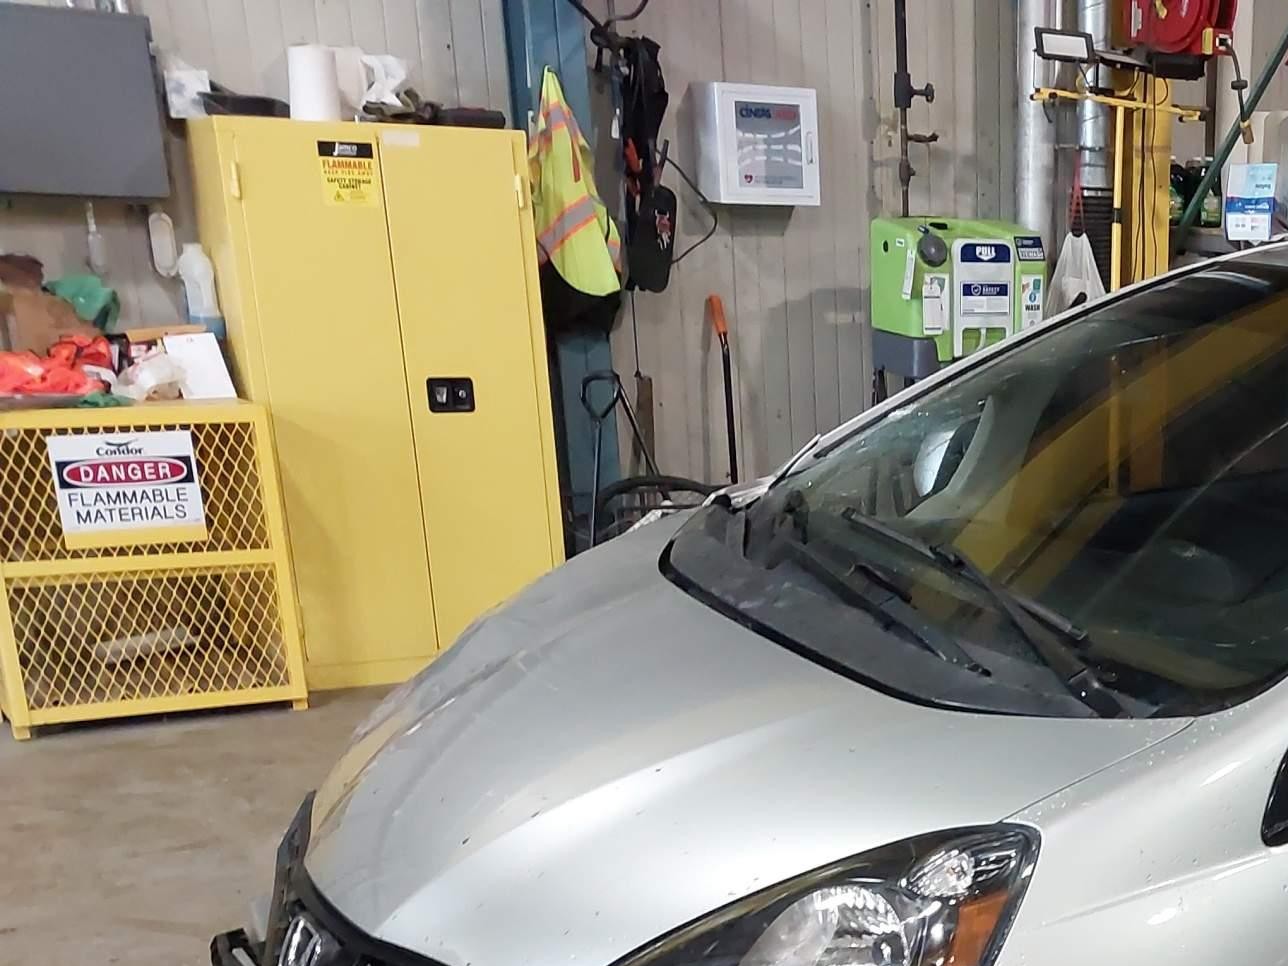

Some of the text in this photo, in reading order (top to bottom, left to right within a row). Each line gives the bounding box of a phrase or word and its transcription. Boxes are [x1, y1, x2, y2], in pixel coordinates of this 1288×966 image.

[322, 160, 372, 170] FLAMMABLE
[976, 245, 996, 257] PULL
[96, 446, 144, 456] Condor
[79, 462, 171, 482] DANGER
[68, 487, 188, 507] FLAMMABLE
[76, 504, 187, 524] MATERIALS
